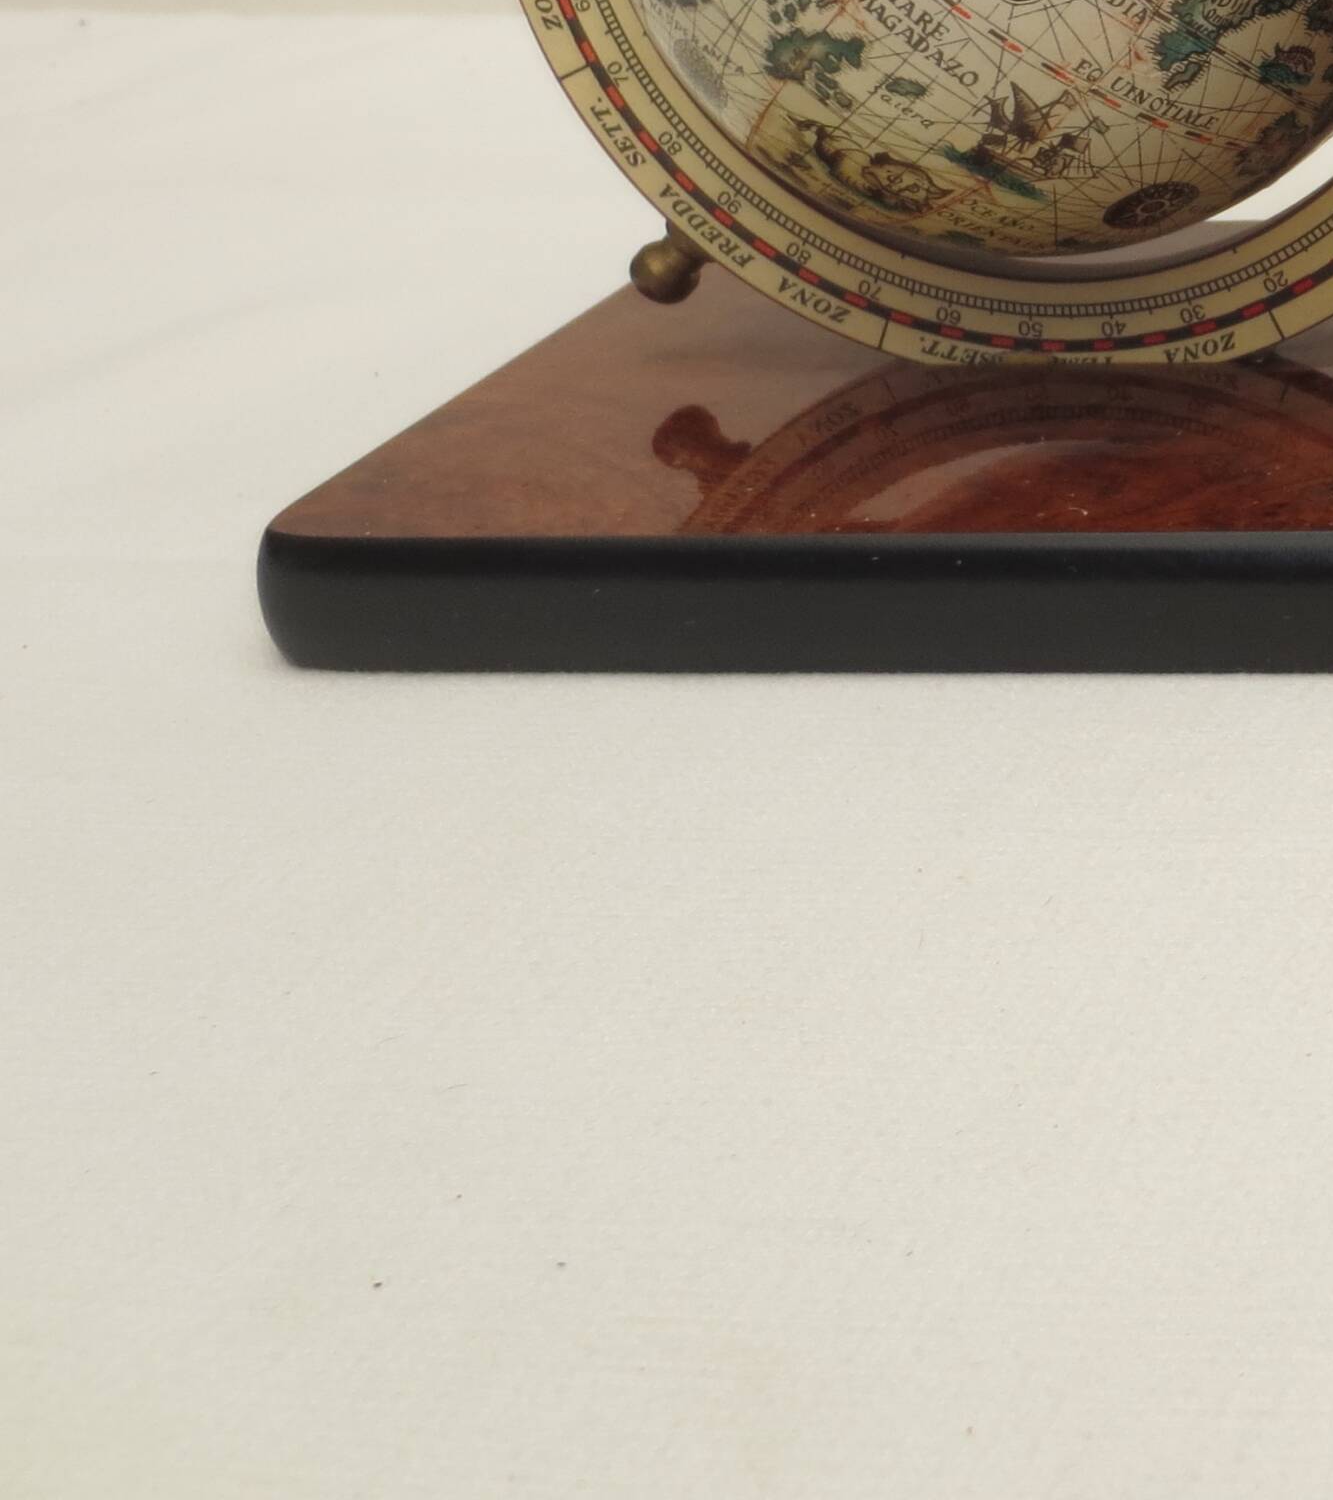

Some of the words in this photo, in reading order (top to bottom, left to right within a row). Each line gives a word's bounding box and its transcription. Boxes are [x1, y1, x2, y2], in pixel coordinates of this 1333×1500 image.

[607, 59, 632, 87] 70
[591, 96, 647, 169] SETT.
[658, 132, 683, 157] 80
[716, 191, 742, 215] 90
[660, 184, 756, 270] FREDDA
[786, 241, 813, 265] 80
[858, 279, 883, 300] 70
[1263, 270, 1290, 294] 20
[777, 275, 854, 325] ZONA
[936, 307, 961, 324] 60
[1180, 304, 1206, 323] 30
[1018, 320, 1044, 337] 50
[1101, 321, 1127, 337] 40
[1163, 331, 1236, 364] ZONA
